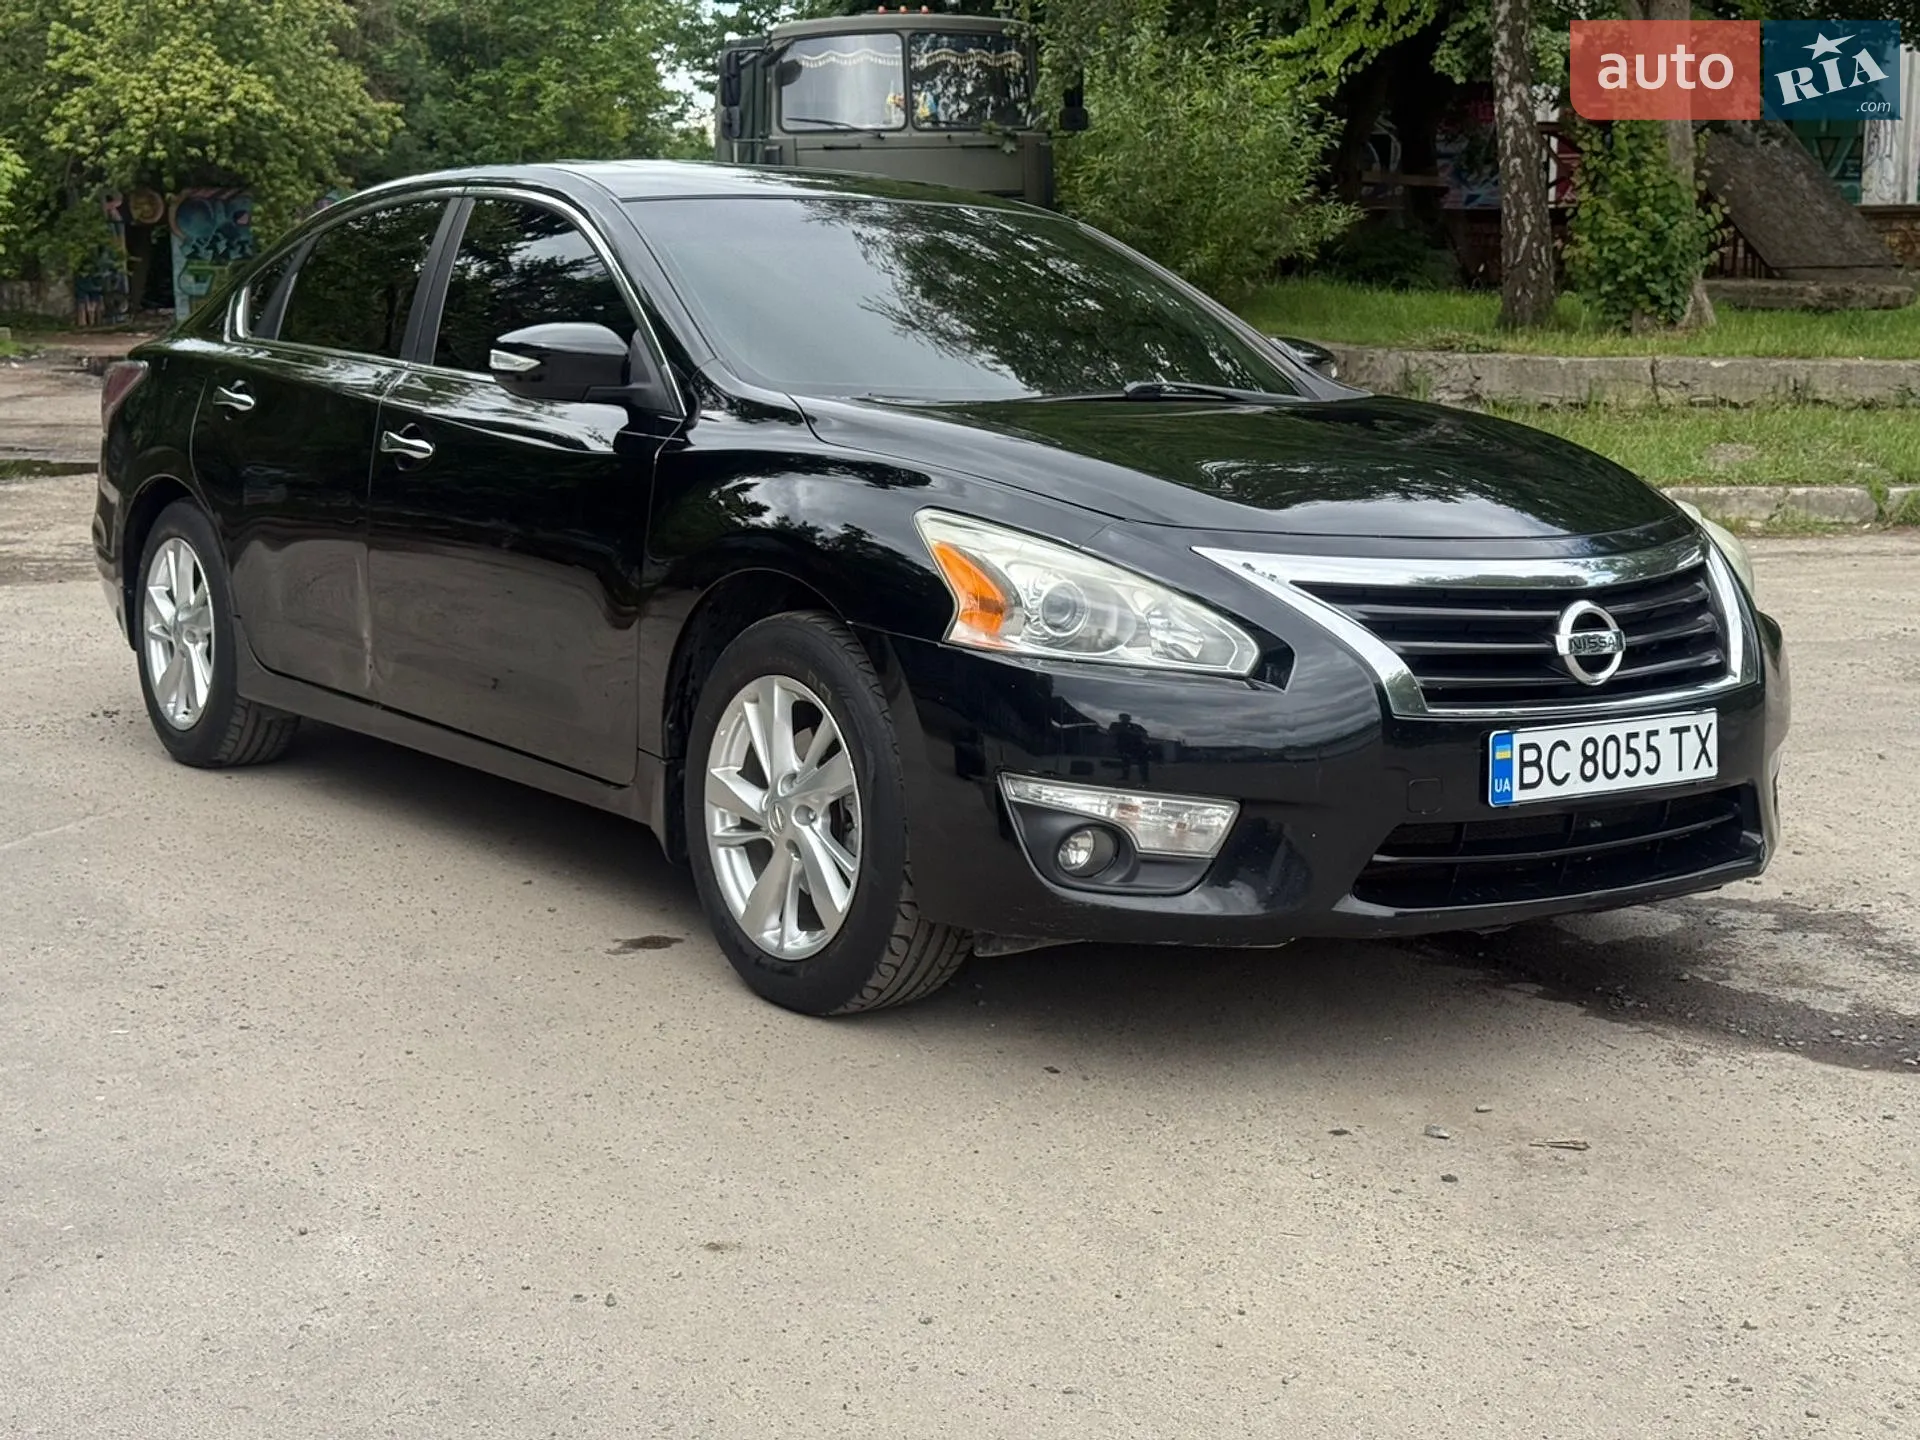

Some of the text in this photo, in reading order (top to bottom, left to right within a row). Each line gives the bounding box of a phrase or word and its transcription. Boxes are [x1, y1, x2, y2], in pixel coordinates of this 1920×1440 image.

[1519, 722, 1713, 790] BC 8055 TX
[1494, 778, 1511, 793] UA
